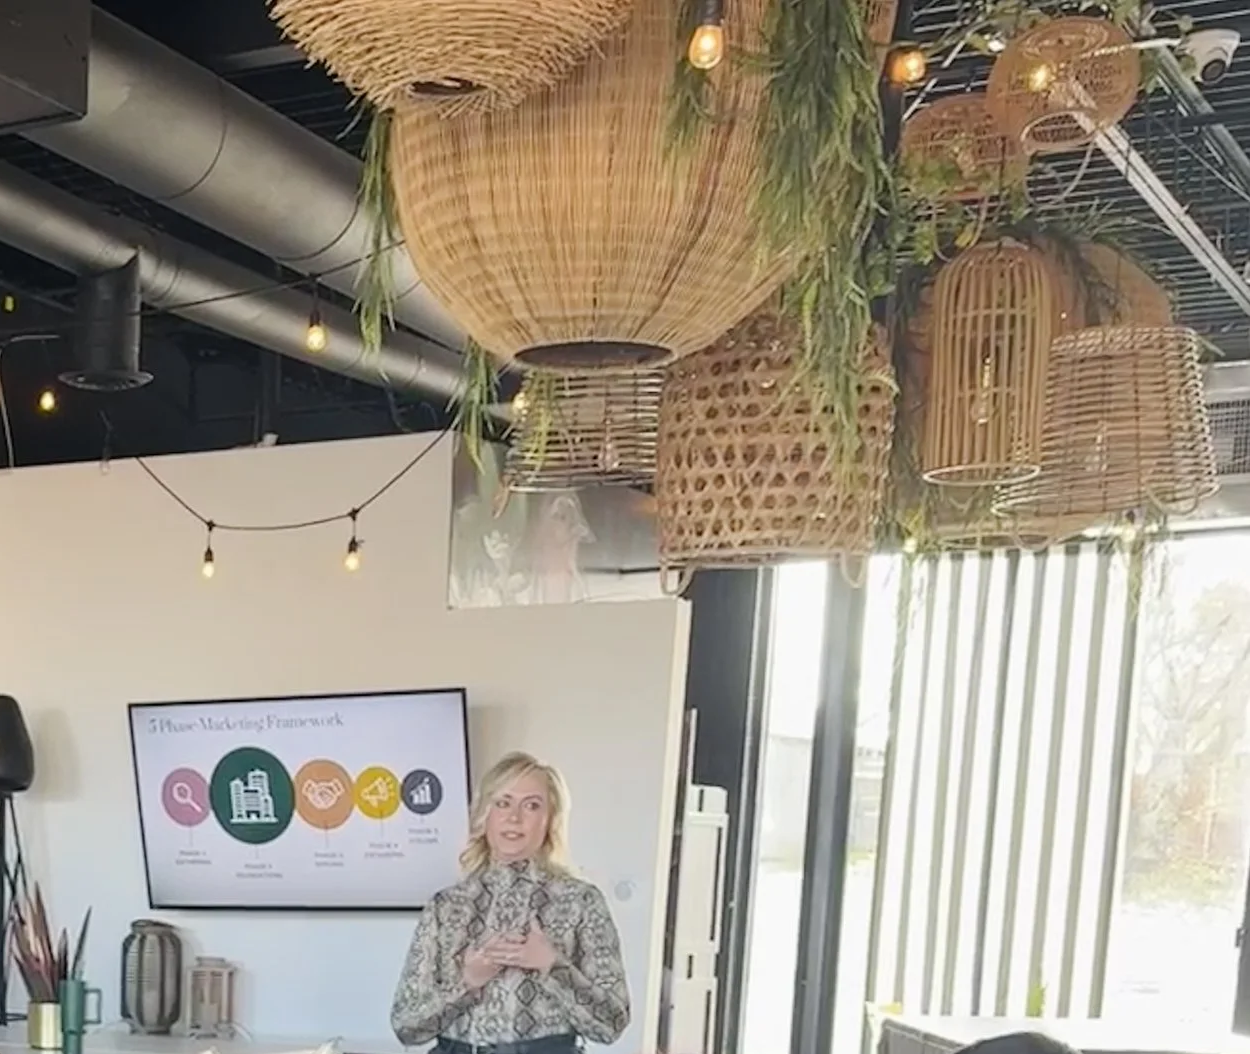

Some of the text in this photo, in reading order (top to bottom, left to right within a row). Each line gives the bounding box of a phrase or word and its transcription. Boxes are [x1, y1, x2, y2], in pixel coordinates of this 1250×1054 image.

[159, 716, 196, 732] Phase
[198, 714, 264, 734] Marketing
[266, 711, 344, 728] Framework
